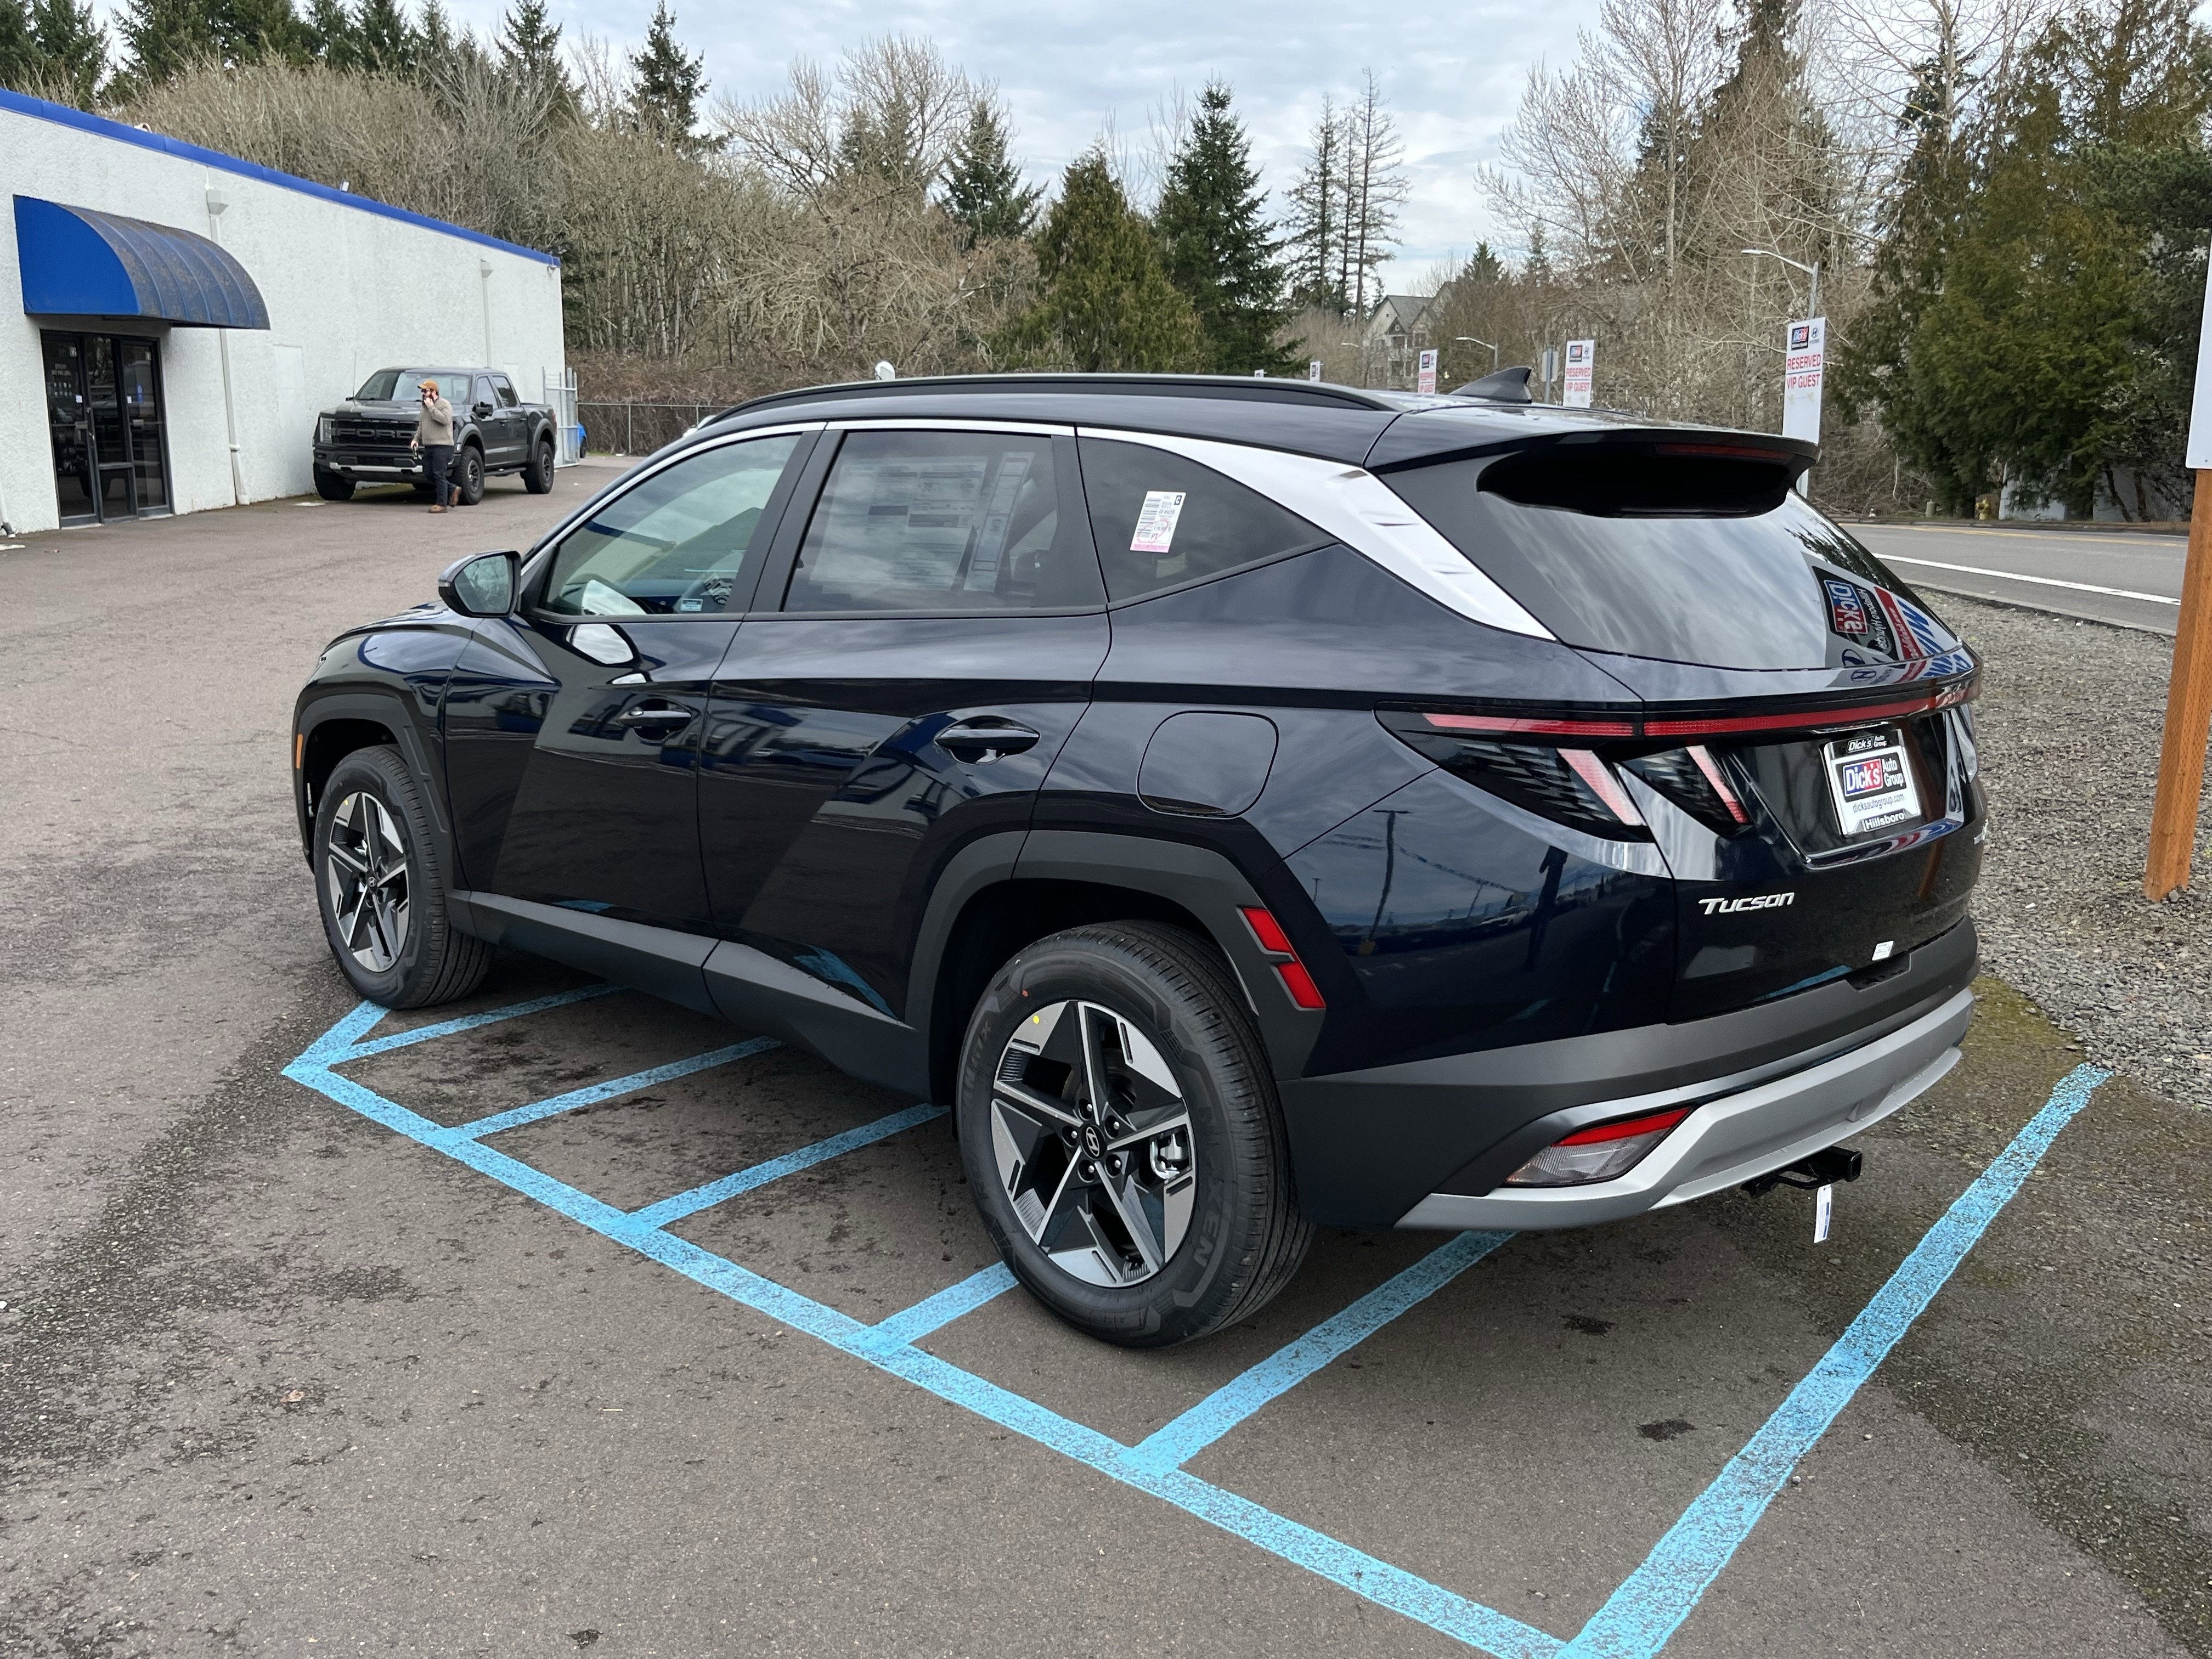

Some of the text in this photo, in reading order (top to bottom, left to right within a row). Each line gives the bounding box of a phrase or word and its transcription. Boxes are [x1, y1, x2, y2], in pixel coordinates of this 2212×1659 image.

[1787, 354, 1821, 370] RESERVED
[1565, 367, 1591, 377] RESERVED
[1573, 382, 1590, 392] GUEST
[1786, 374, 1820, 390] VIP GUEST
[1848, 737, 1872, 751] Dick's
[1845, 758, 1897, 792] Dick's Auto
[1883, 772, 1904, 787] Group
[1853, 793, 1905, 813] dicksautogroup.com
[1864, 812, 1905, 830] Hillsboro
